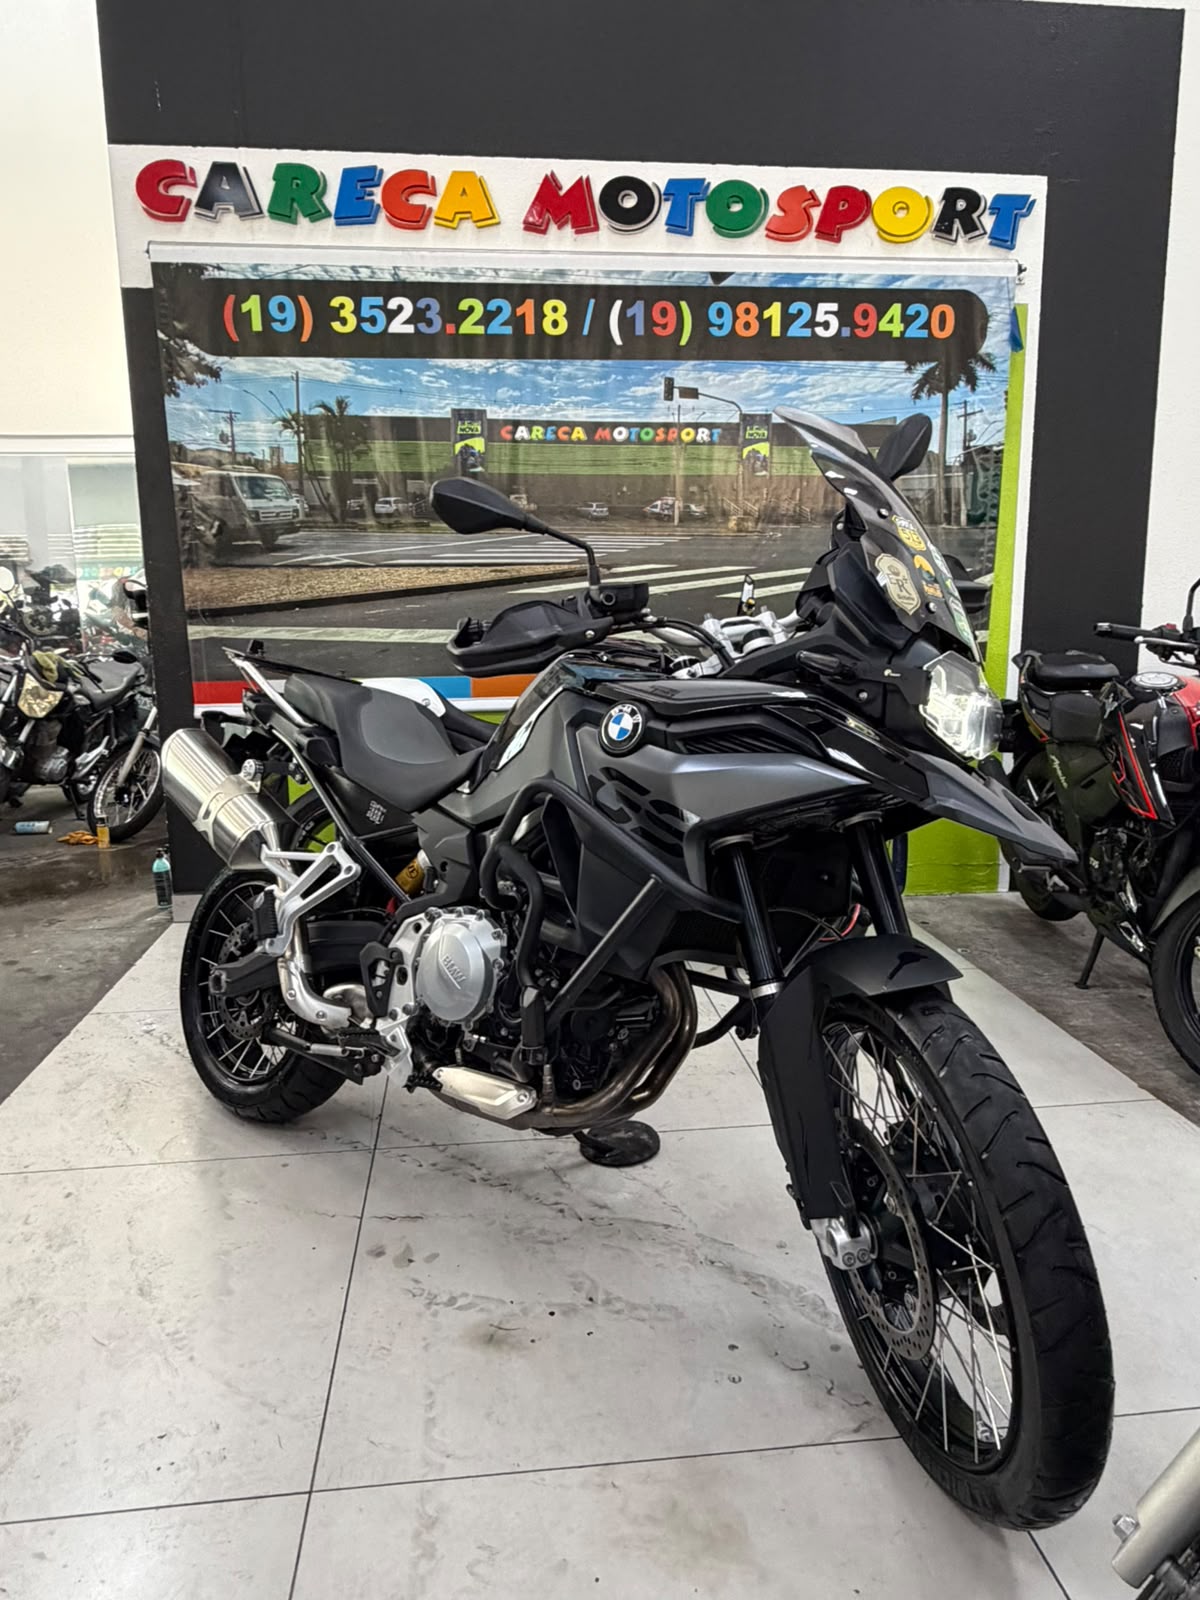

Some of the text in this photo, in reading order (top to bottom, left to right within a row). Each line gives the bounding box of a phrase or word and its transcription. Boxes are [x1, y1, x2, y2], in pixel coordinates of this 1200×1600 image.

[135, 158, 1036, 250] CARECA MOTOSPORT
[223, 294, 313, 343] (19)
[330, 296, 568, 336] 3523.2218
[609, 299, 692, 346] (19)
[708, 301, 955, 340] 98125.9420
[500, 425, 722, 443] CARECA MOTOSPORT
[610, 704, 643, 724] BMW
[442, 954, 467, 983] BMW
